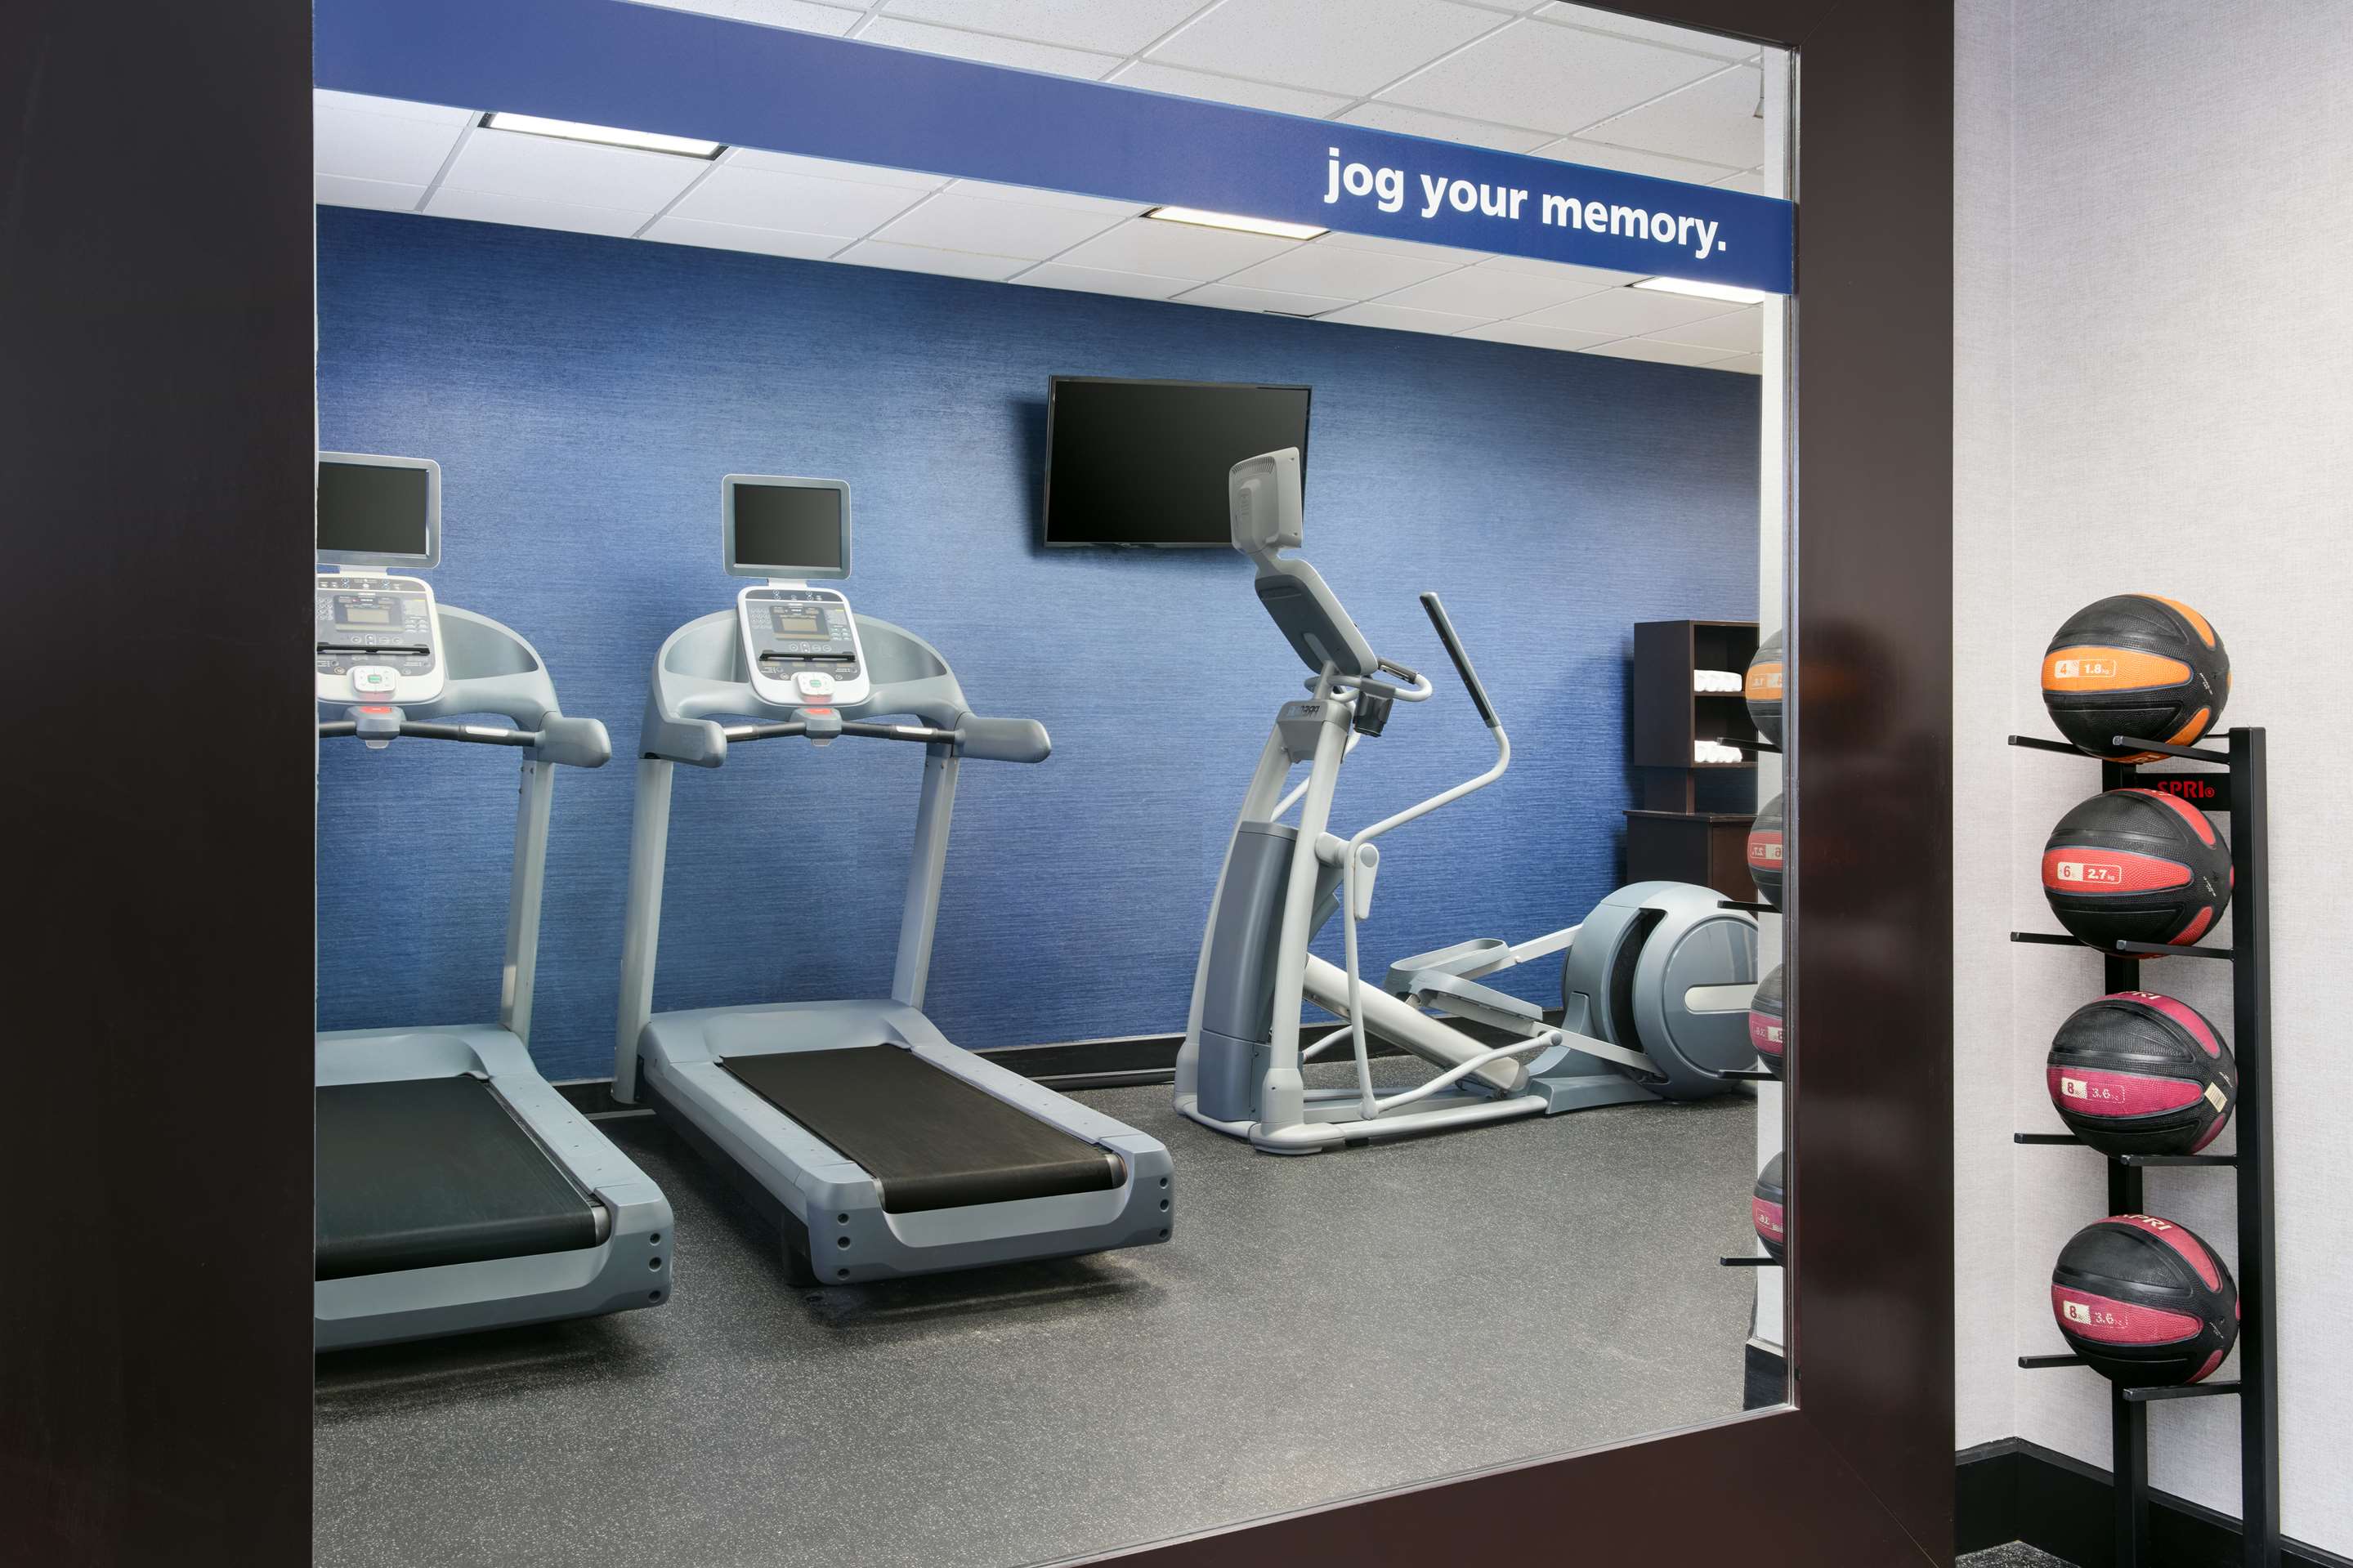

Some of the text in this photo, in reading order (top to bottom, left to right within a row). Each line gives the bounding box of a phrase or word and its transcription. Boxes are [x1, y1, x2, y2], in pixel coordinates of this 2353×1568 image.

[1324, 147, 1726, 259] jog your memory.
[2064, 865, 2071, 878] 6
[2087, 869, 2107, 879] 2.7
[2067, 1082, 2074, 1094] 8
[2069, 1306, 2077, 1319] 8
